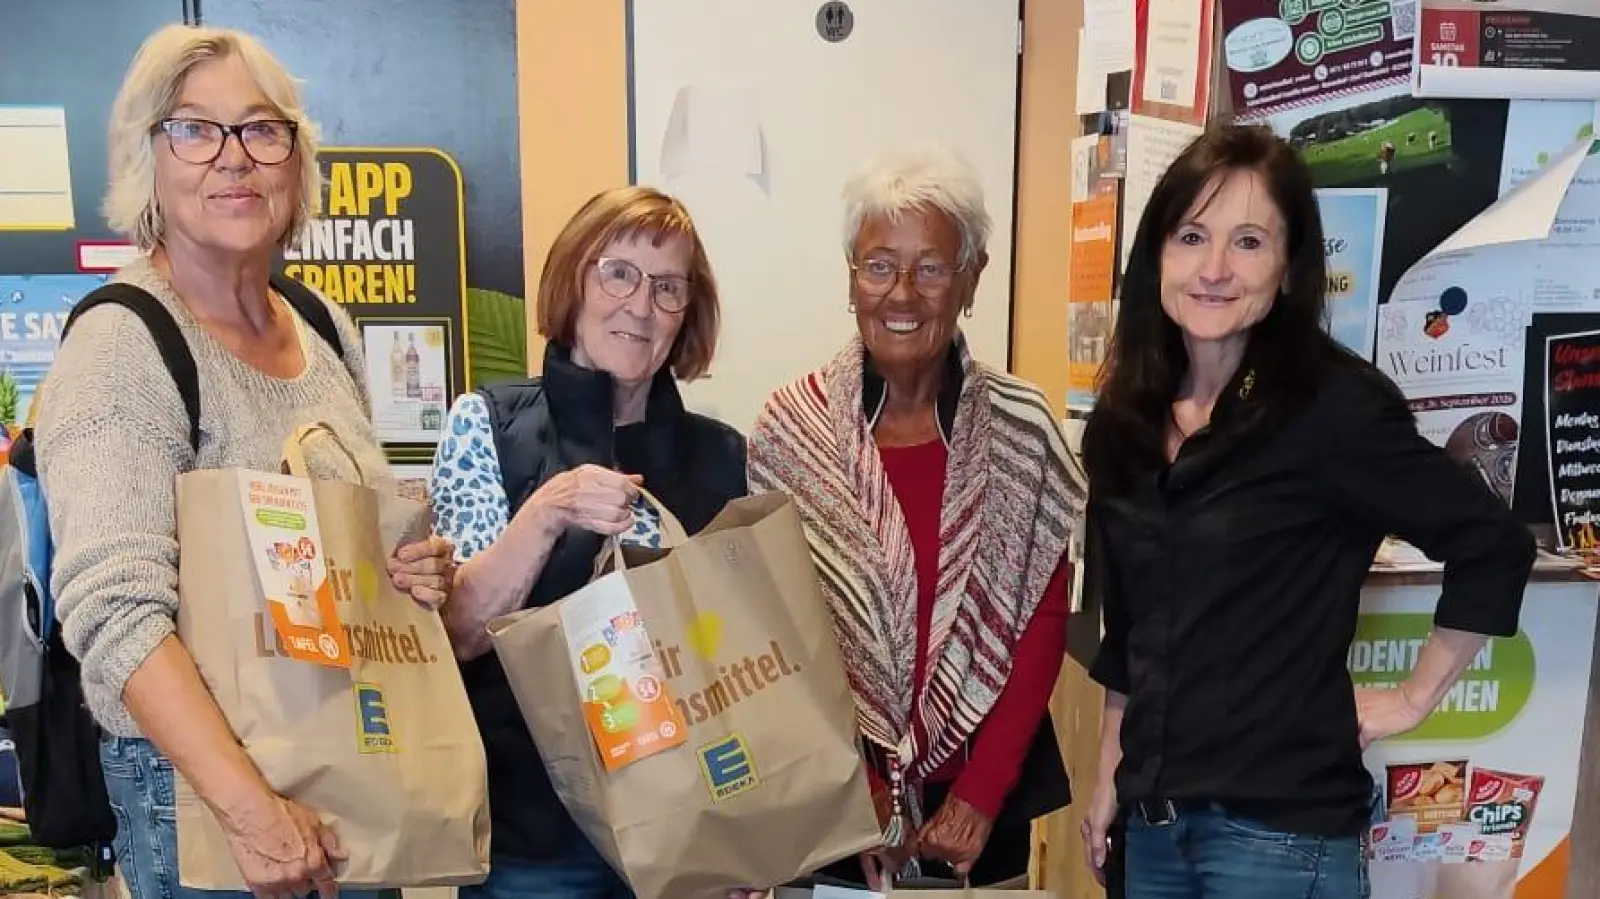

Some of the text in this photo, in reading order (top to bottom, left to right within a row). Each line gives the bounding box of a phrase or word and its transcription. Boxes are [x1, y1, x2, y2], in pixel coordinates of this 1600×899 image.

[826, 25, 845, 37] WC
[329, 162, 412, 216] APP
[1389, 344, 1507, 377] Weinfest
